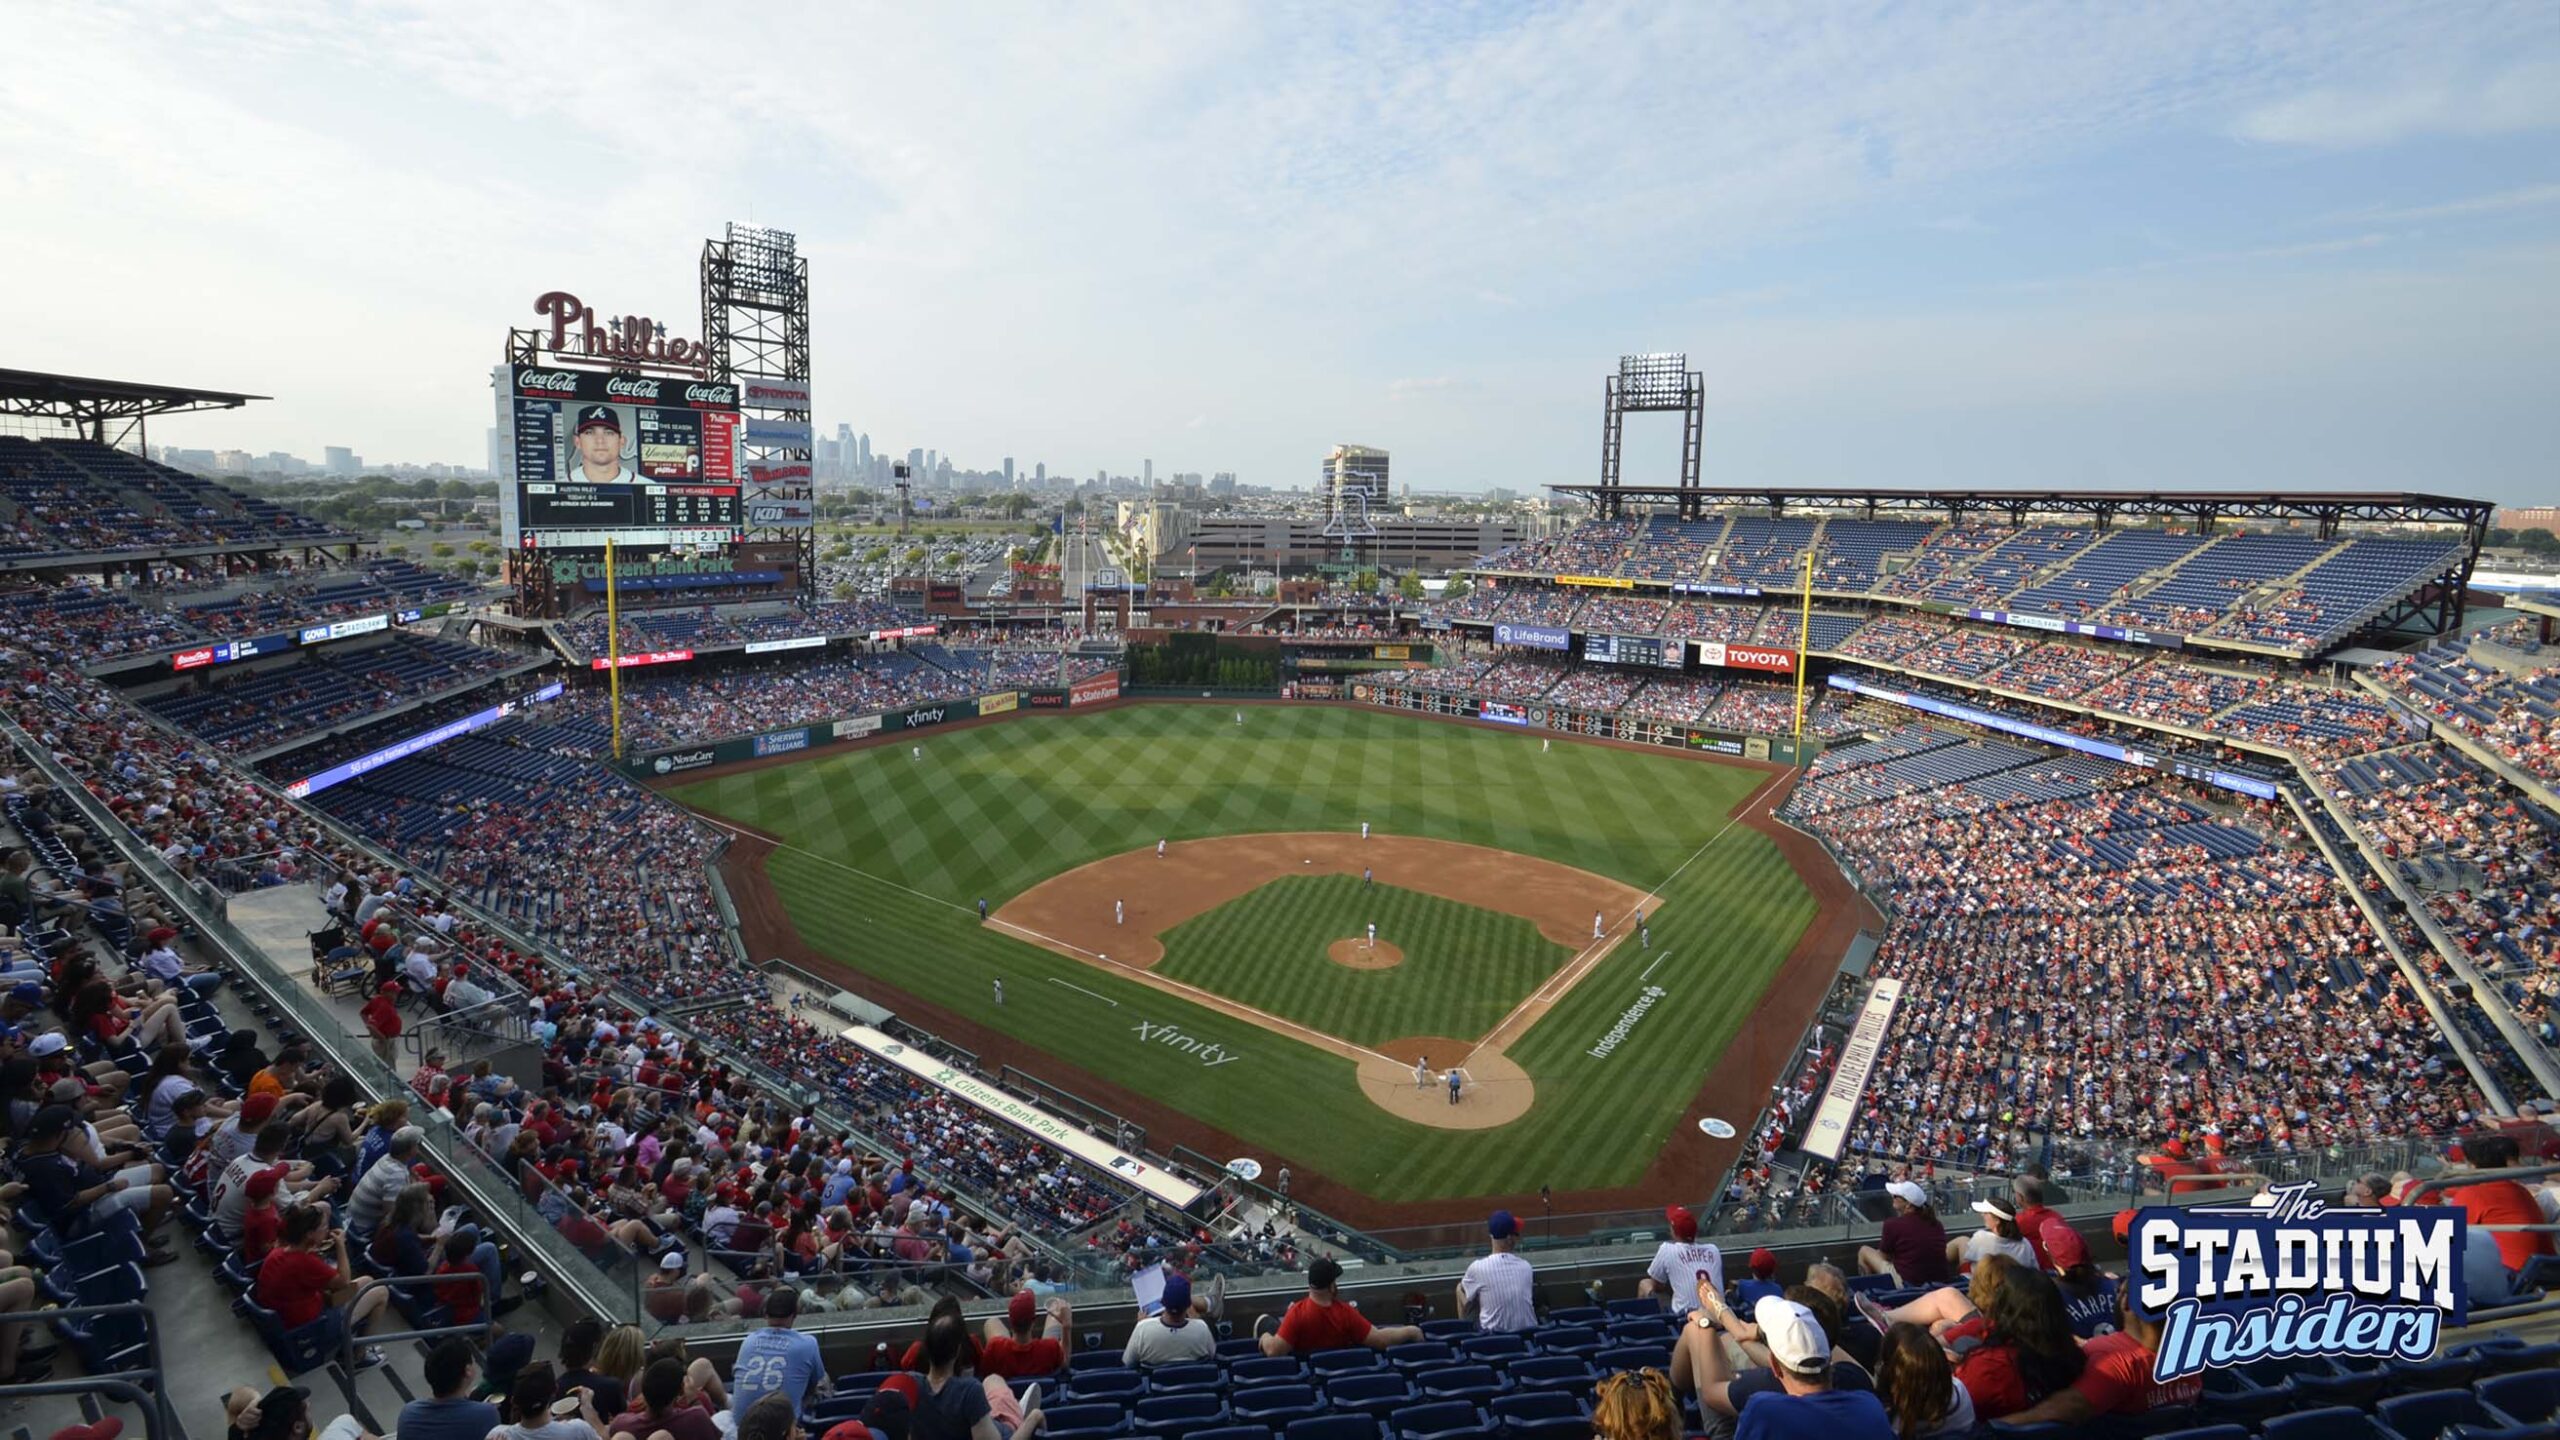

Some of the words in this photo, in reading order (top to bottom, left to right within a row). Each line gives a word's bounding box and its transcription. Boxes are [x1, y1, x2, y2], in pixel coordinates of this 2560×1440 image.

[534, 291, 711, 368] Phillies
[518, 369, 579, 392] Coca-Cola
[606, 377, 662, 398] Coca-Cola
[685, 384, 734, 404] Coca-Cola
[762, 387, 808, 400] TOYOTA
[700, 532, 708, 541] 2
[581, 562, 653, 579] Citzens
[655, 560, 697, 575] Bank
[699, 557, 734, 573] Park
[1514, 630, 1565, 645] LifeBrand
[668, 650, 687, 661] Boys
[1728, 650, 1789, 667] TOYOTA
[1031, 695, 1063, 704] GIANT
[906, 707, 945, 727] xfinity
[768, 732, 804, 744] SHERWIN
[1692, 737, 1741, 749] DRAFTKINGS
[673, 751, 715, 766] NovaCare
[1586, 995, 1656, 1059] Independence
[1130, 1021, 1239, 1066] xfinity
[1830, 1043, 1874, 1103] PHILADELPHIA
[1856, 1010, 1887, 1043] PHILLIES
[954, 1079, 1005, 1108] Citizens
[1002, 1103, 1038, 1125] Bank
[1035, 1119, 1069, 1140] Park
[824, 1184, 835, 1199] 3
[1678, 1249, 1715, 1265] HARPER
[2066, 1294, 2114, 1322] HARPE
[741, 1355, 787, 1391] 26
